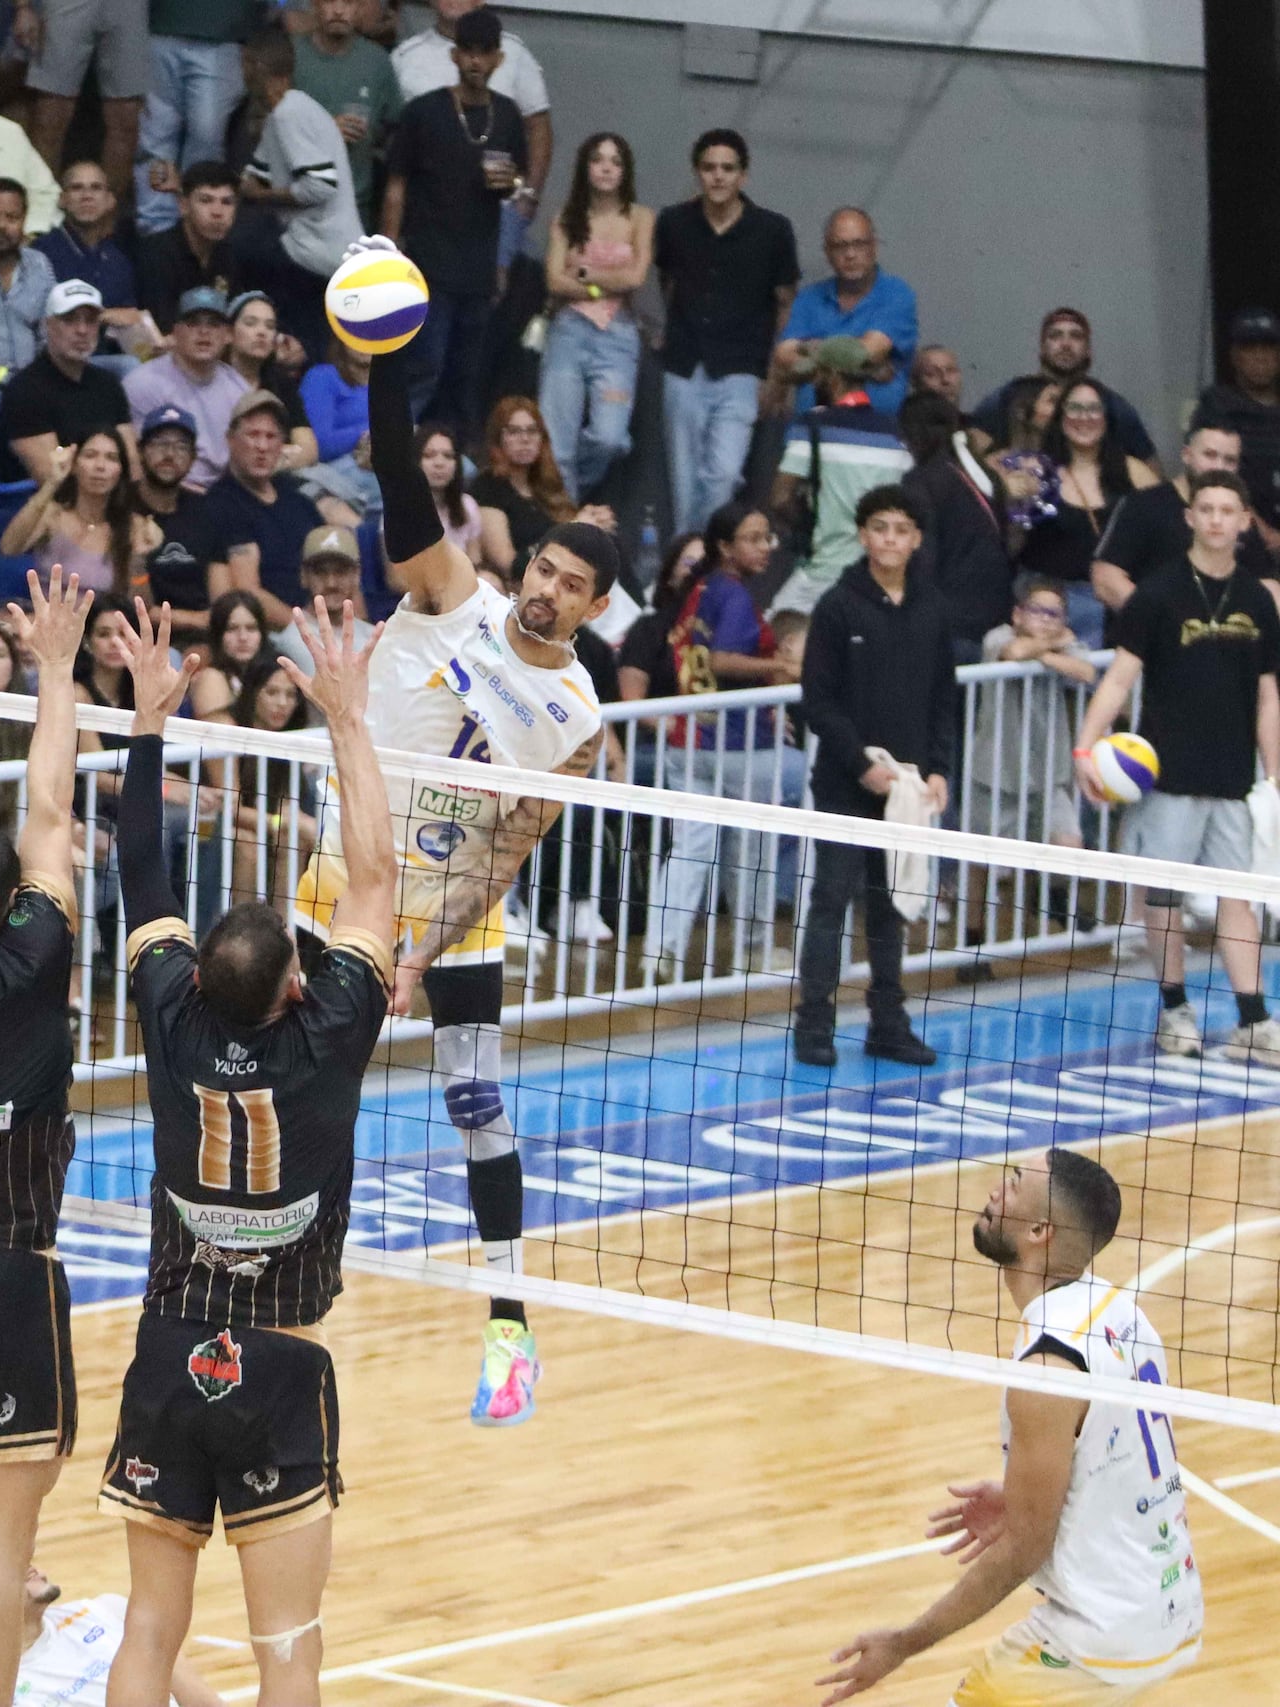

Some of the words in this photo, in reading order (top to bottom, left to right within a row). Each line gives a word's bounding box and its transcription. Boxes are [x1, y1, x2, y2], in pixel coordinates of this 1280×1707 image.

[487, 673, 535, 728] Business
[546, 701, 569, 724] 63
[417, 786, 482, 822] MCS
[214, 1057, 258, 1076] YAUCO
[192, 1081, 281, 1195] 11
[188, 1201, 314, 1230] LABORATORIO
